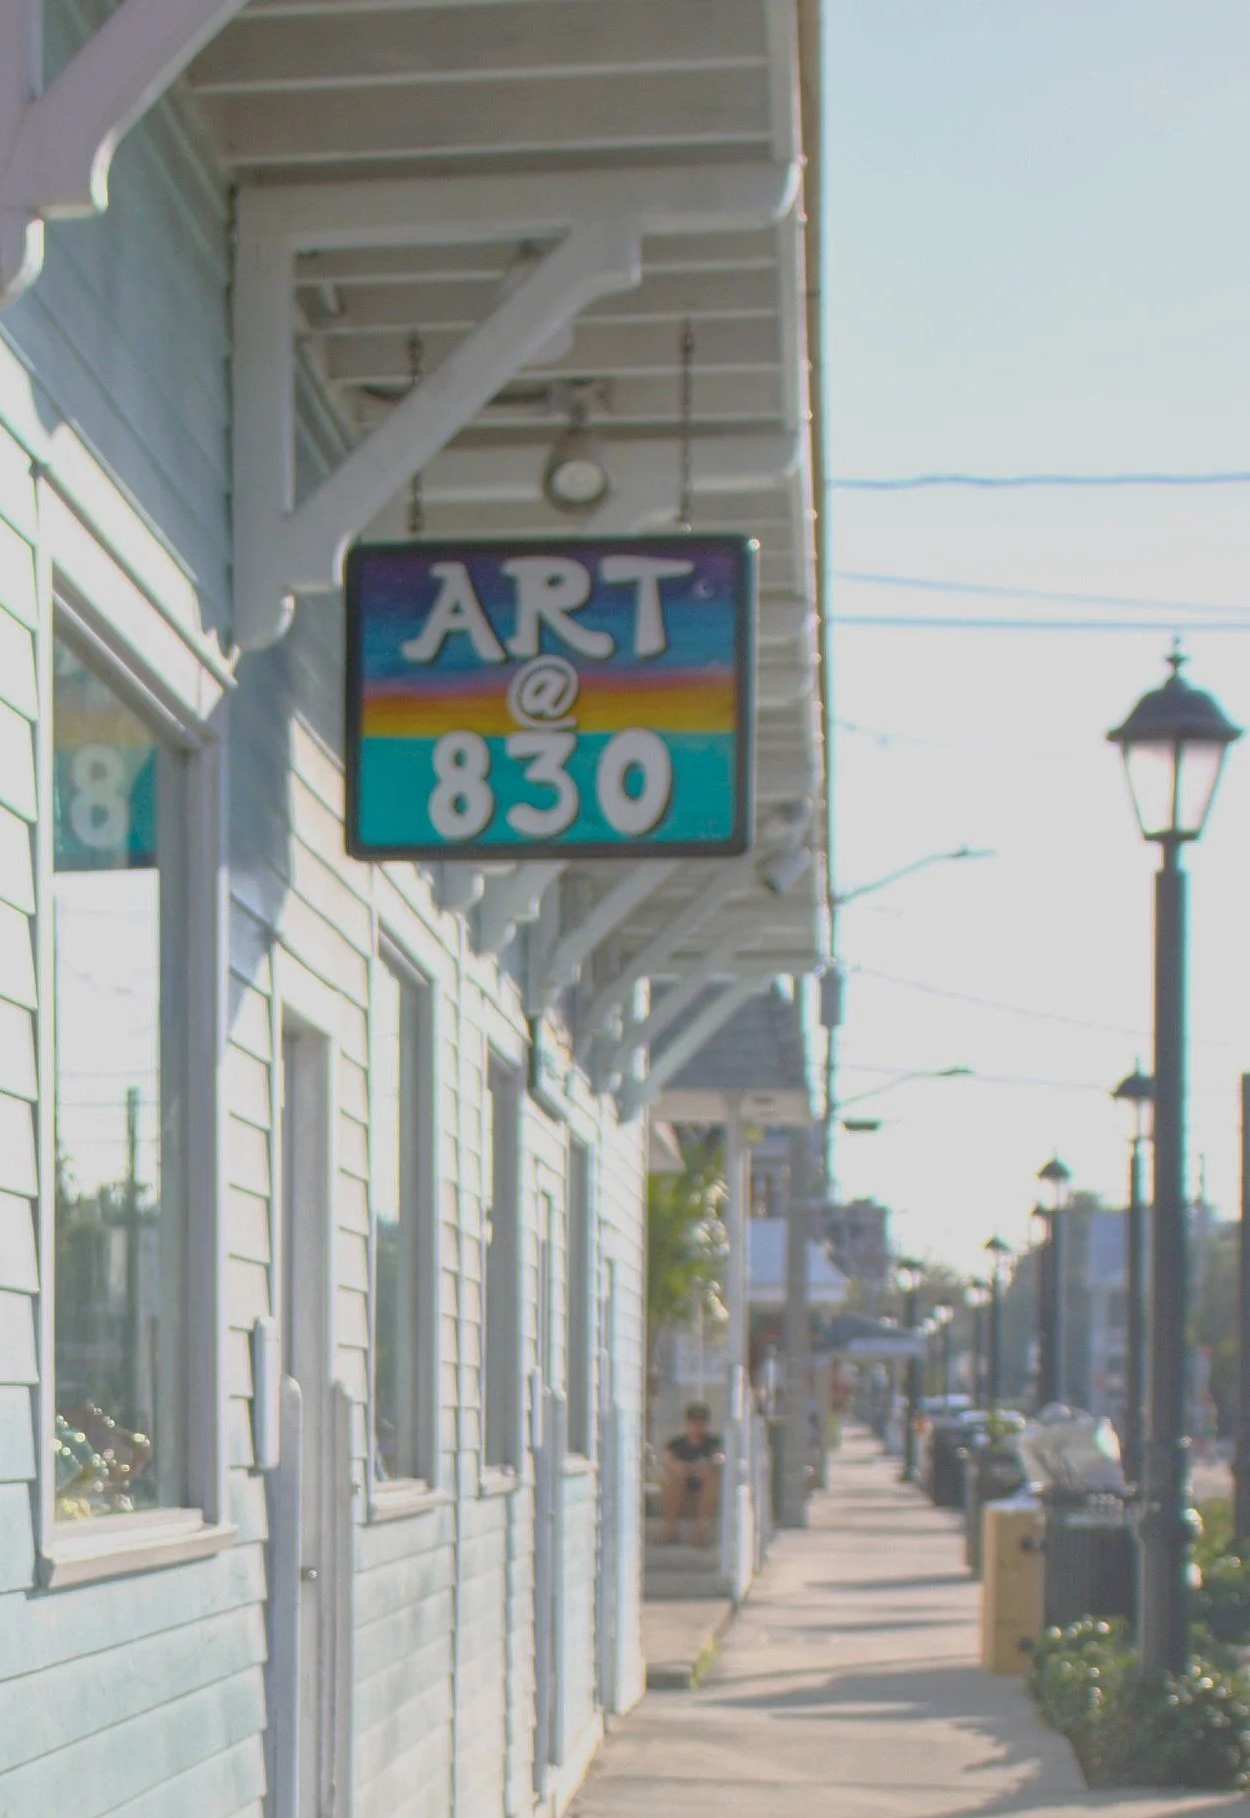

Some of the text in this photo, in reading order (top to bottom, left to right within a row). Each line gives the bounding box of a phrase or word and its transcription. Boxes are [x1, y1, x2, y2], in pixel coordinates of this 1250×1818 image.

[401, 555, 695, 665] ART
[507, 653, 580, 731] @
[428, 727, 673, 842] 830
